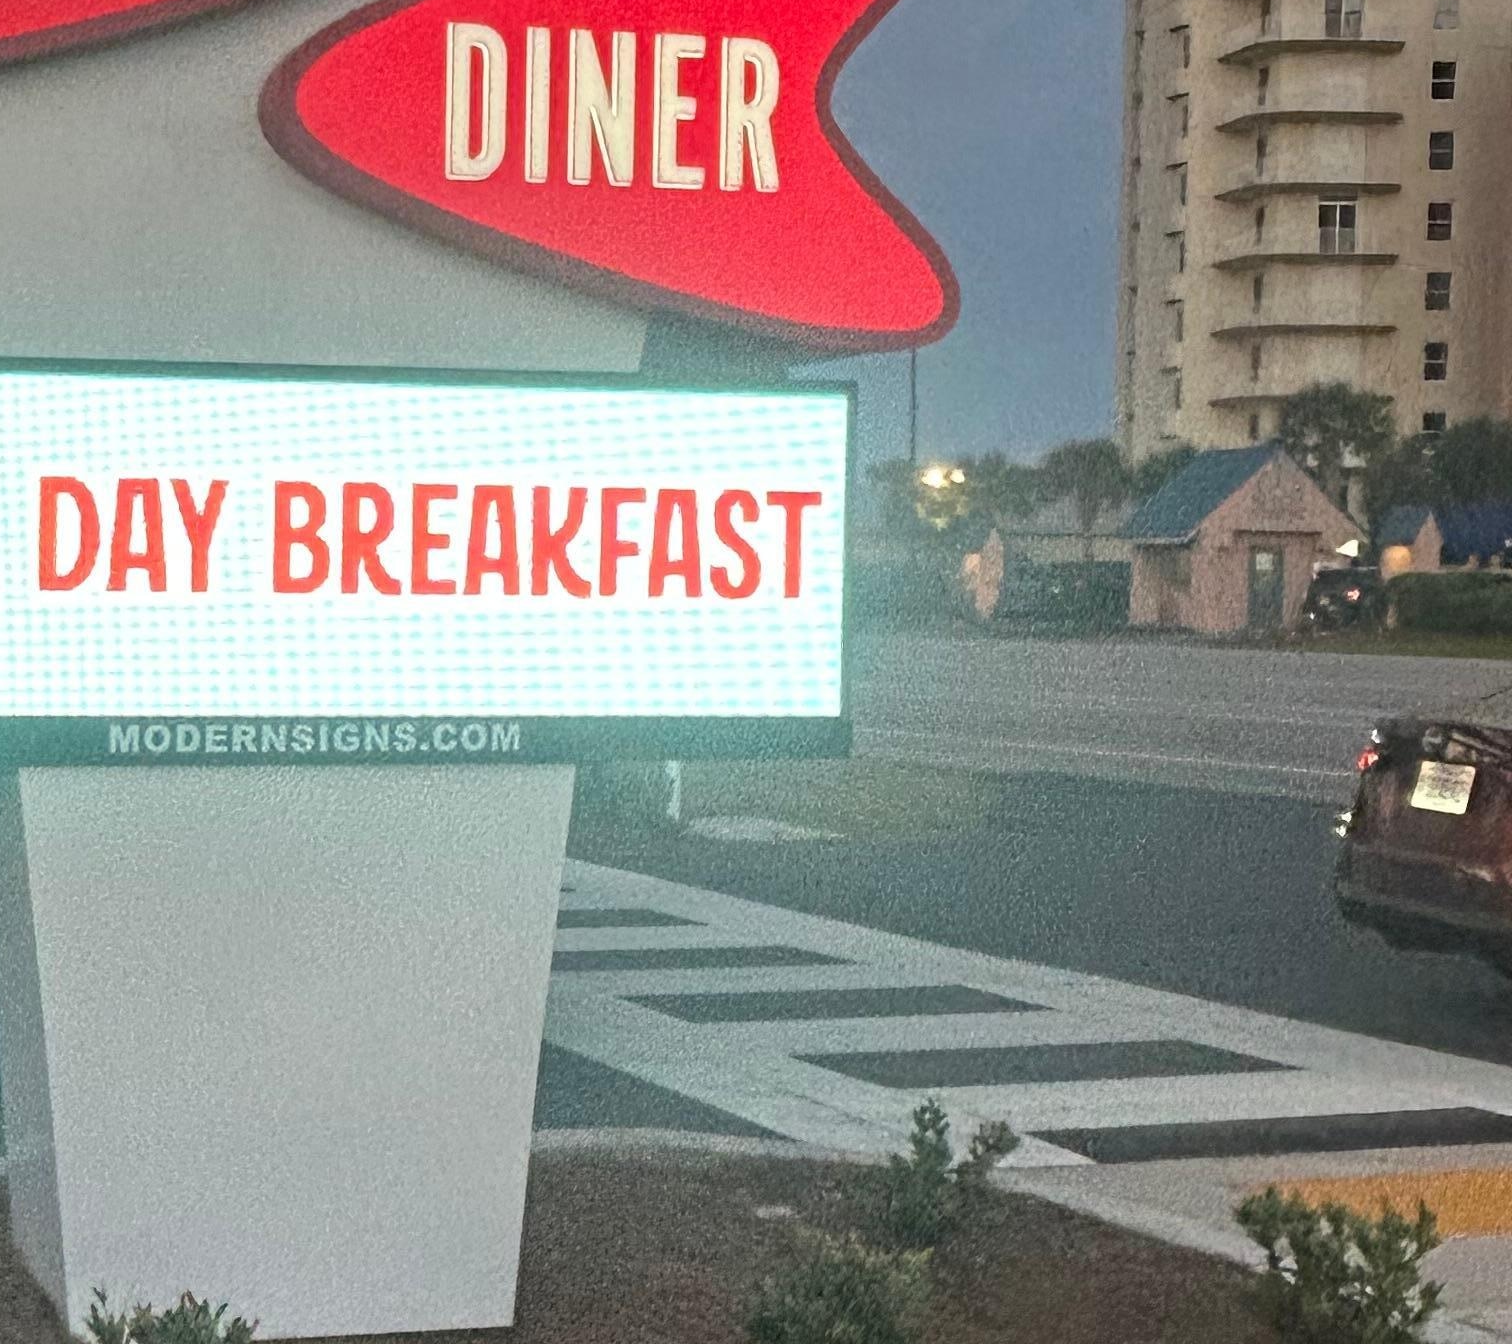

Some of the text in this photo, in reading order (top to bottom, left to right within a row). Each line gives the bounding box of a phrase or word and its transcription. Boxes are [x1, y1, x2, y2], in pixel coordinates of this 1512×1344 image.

[444, 22, 780, 193] DINER
[39, 477, 228, 593] DAY
[273, 481, 823, 599] BREAKFAST
[109, 722, 521, 754] MODERNSIGNS.COM
